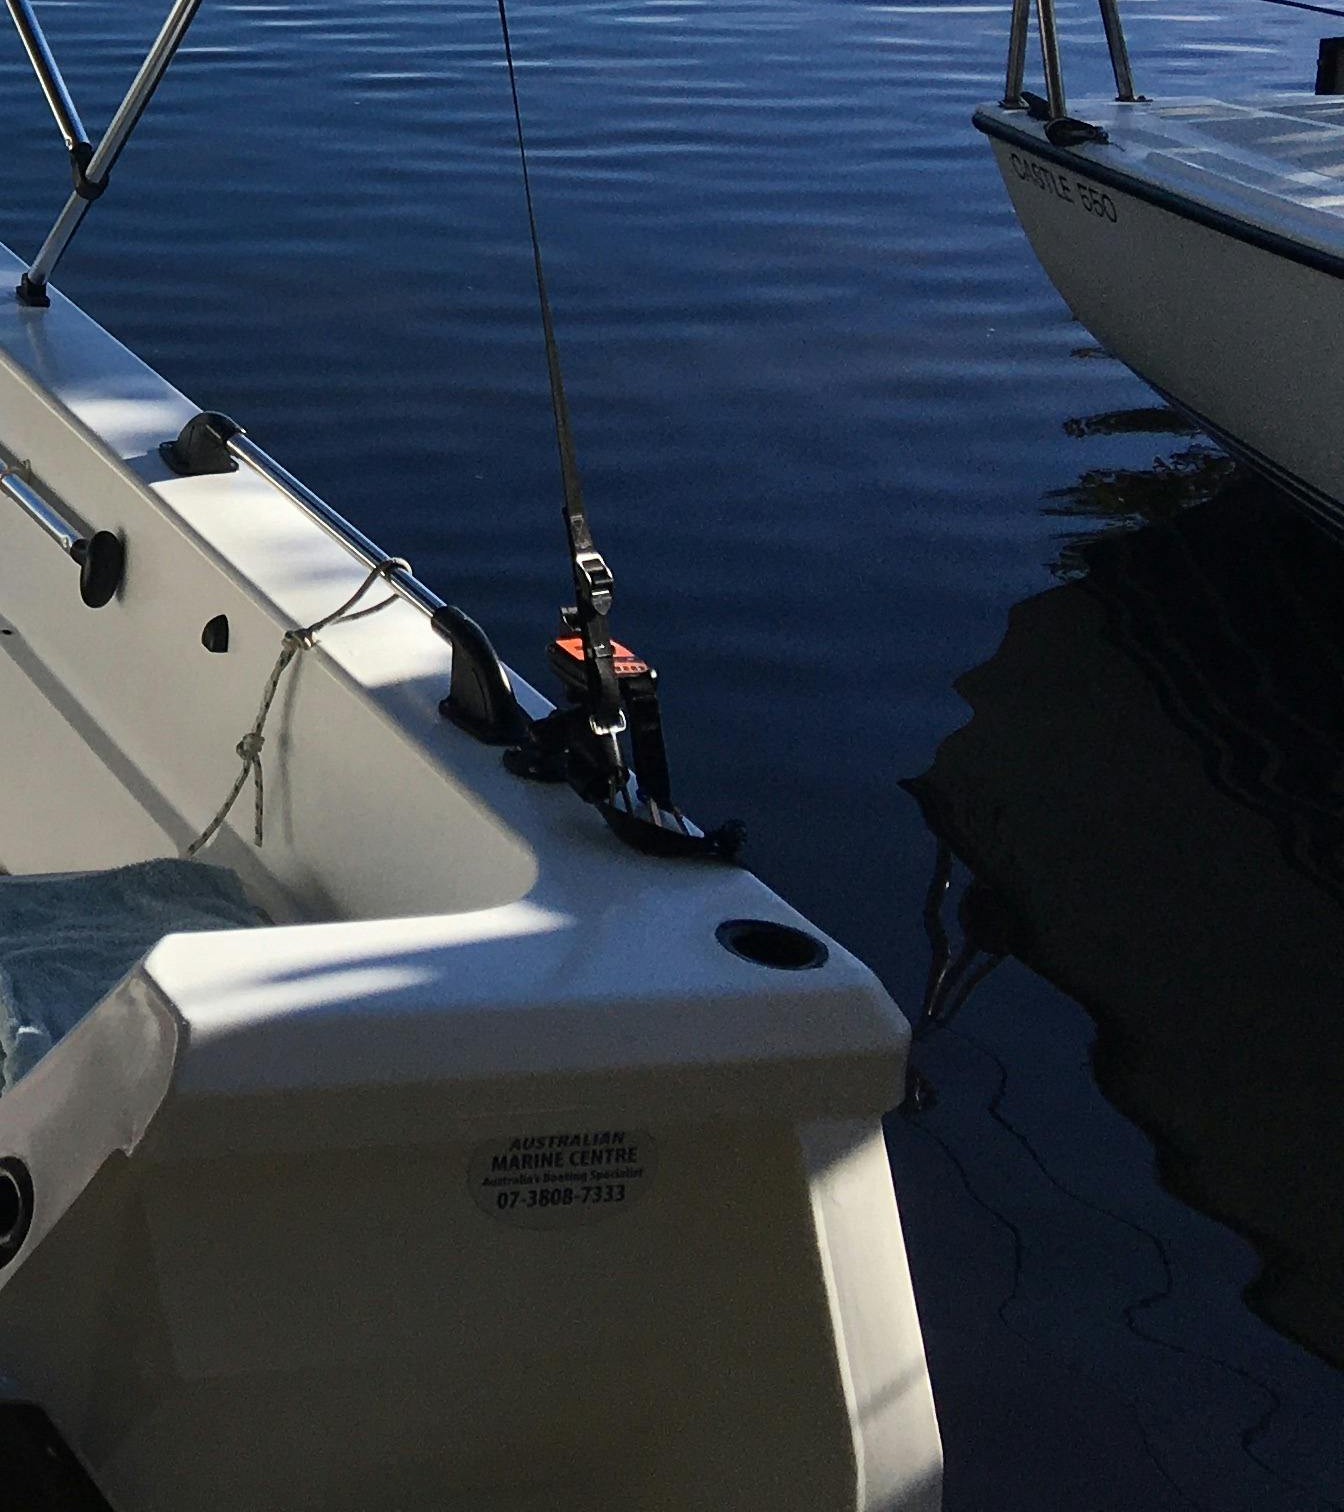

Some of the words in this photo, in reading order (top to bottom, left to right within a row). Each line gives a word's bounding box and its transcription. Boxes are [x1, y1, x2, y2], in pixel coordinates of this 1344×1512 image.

[1010, 153, 1074, 204] CASTLE
[1077, 182, 1118, 223] 550
[509, 1131, 626, 1151] AUSTRALIAN
[491, 1152, 564, 1172] MARINE
[569, 1147, 638, 1167] CENTRE
[482, 1173, 540, 1186] Australia's
[543, 1171, 588, 1184] Boating
[497, 1185, 626, 1209] 07-3808-7333
